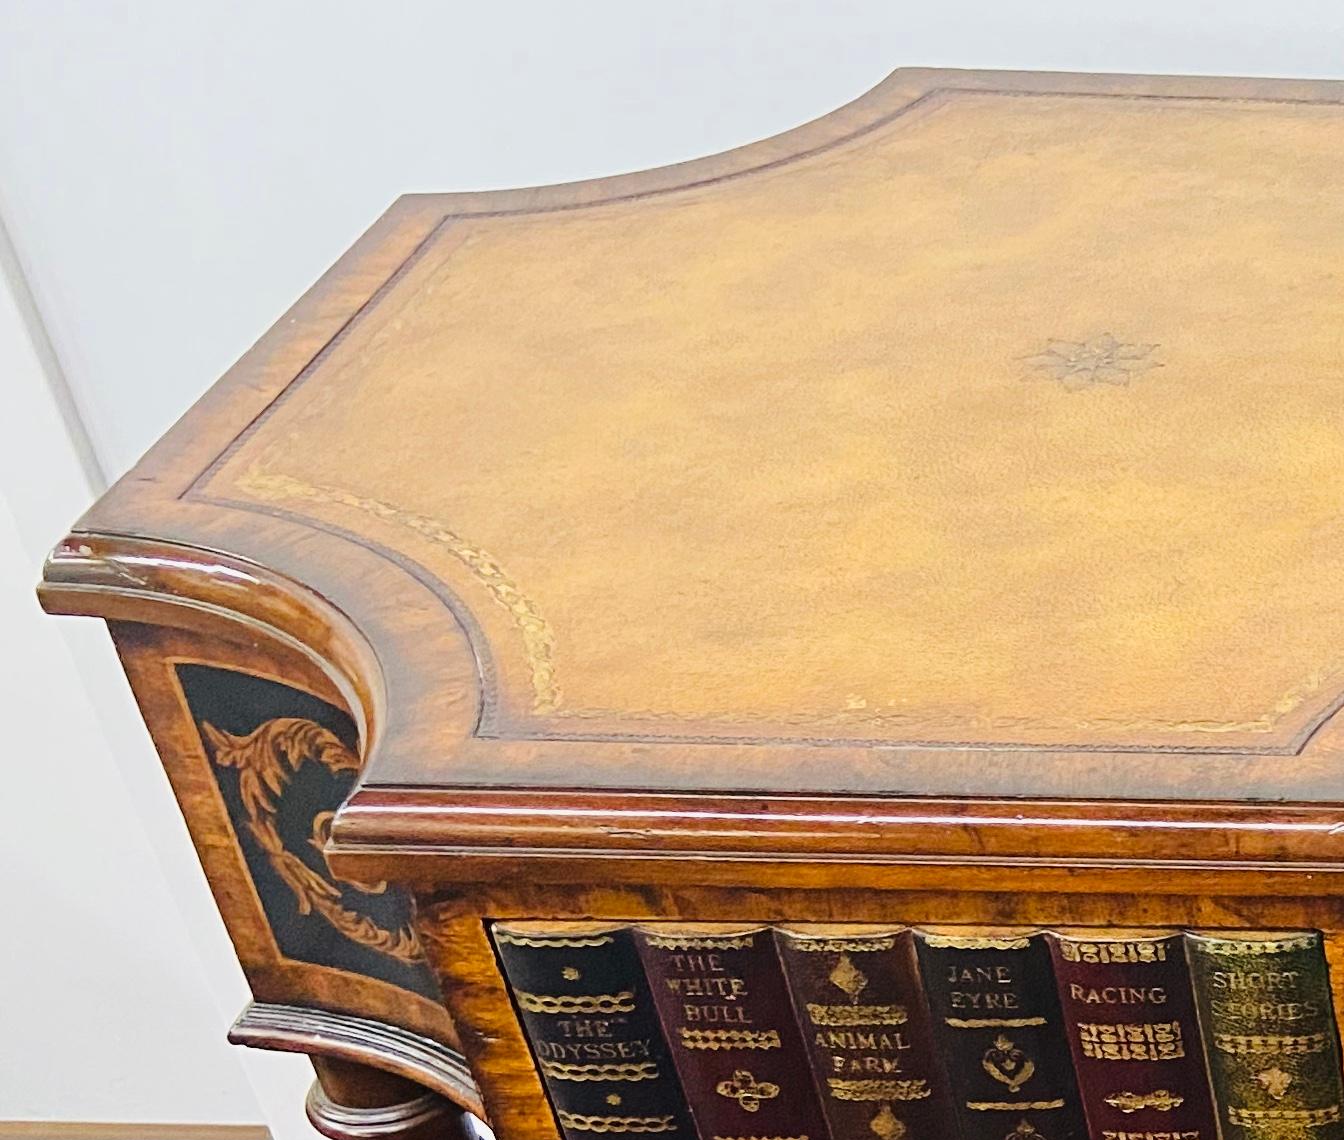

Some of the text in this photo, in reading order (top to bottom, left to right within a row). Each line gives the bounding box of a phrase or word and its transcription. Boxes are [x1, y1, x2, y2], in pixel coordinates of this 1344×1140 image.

[672, 953, 725, 972] THE
[949, 966, 1013, 984] JANE
[1211, 971, 1303, 990] SHORT
[664, 976, 749, 996] WHITE
[1070, 983, 1167, 1005] RACING
[951, 991, 1020, 1010] EYRE
[684, 1004, 753, 1024] BULL
[1211, 1001, 1320, 1020] STORIES
[557, 1019, 613, 1038] THE
[538, 1040, 651, 1060] ODYSSEY
[814, 1032, 911, 1050] ANIMAL
[832, 1055, 903, 1073] FARM
